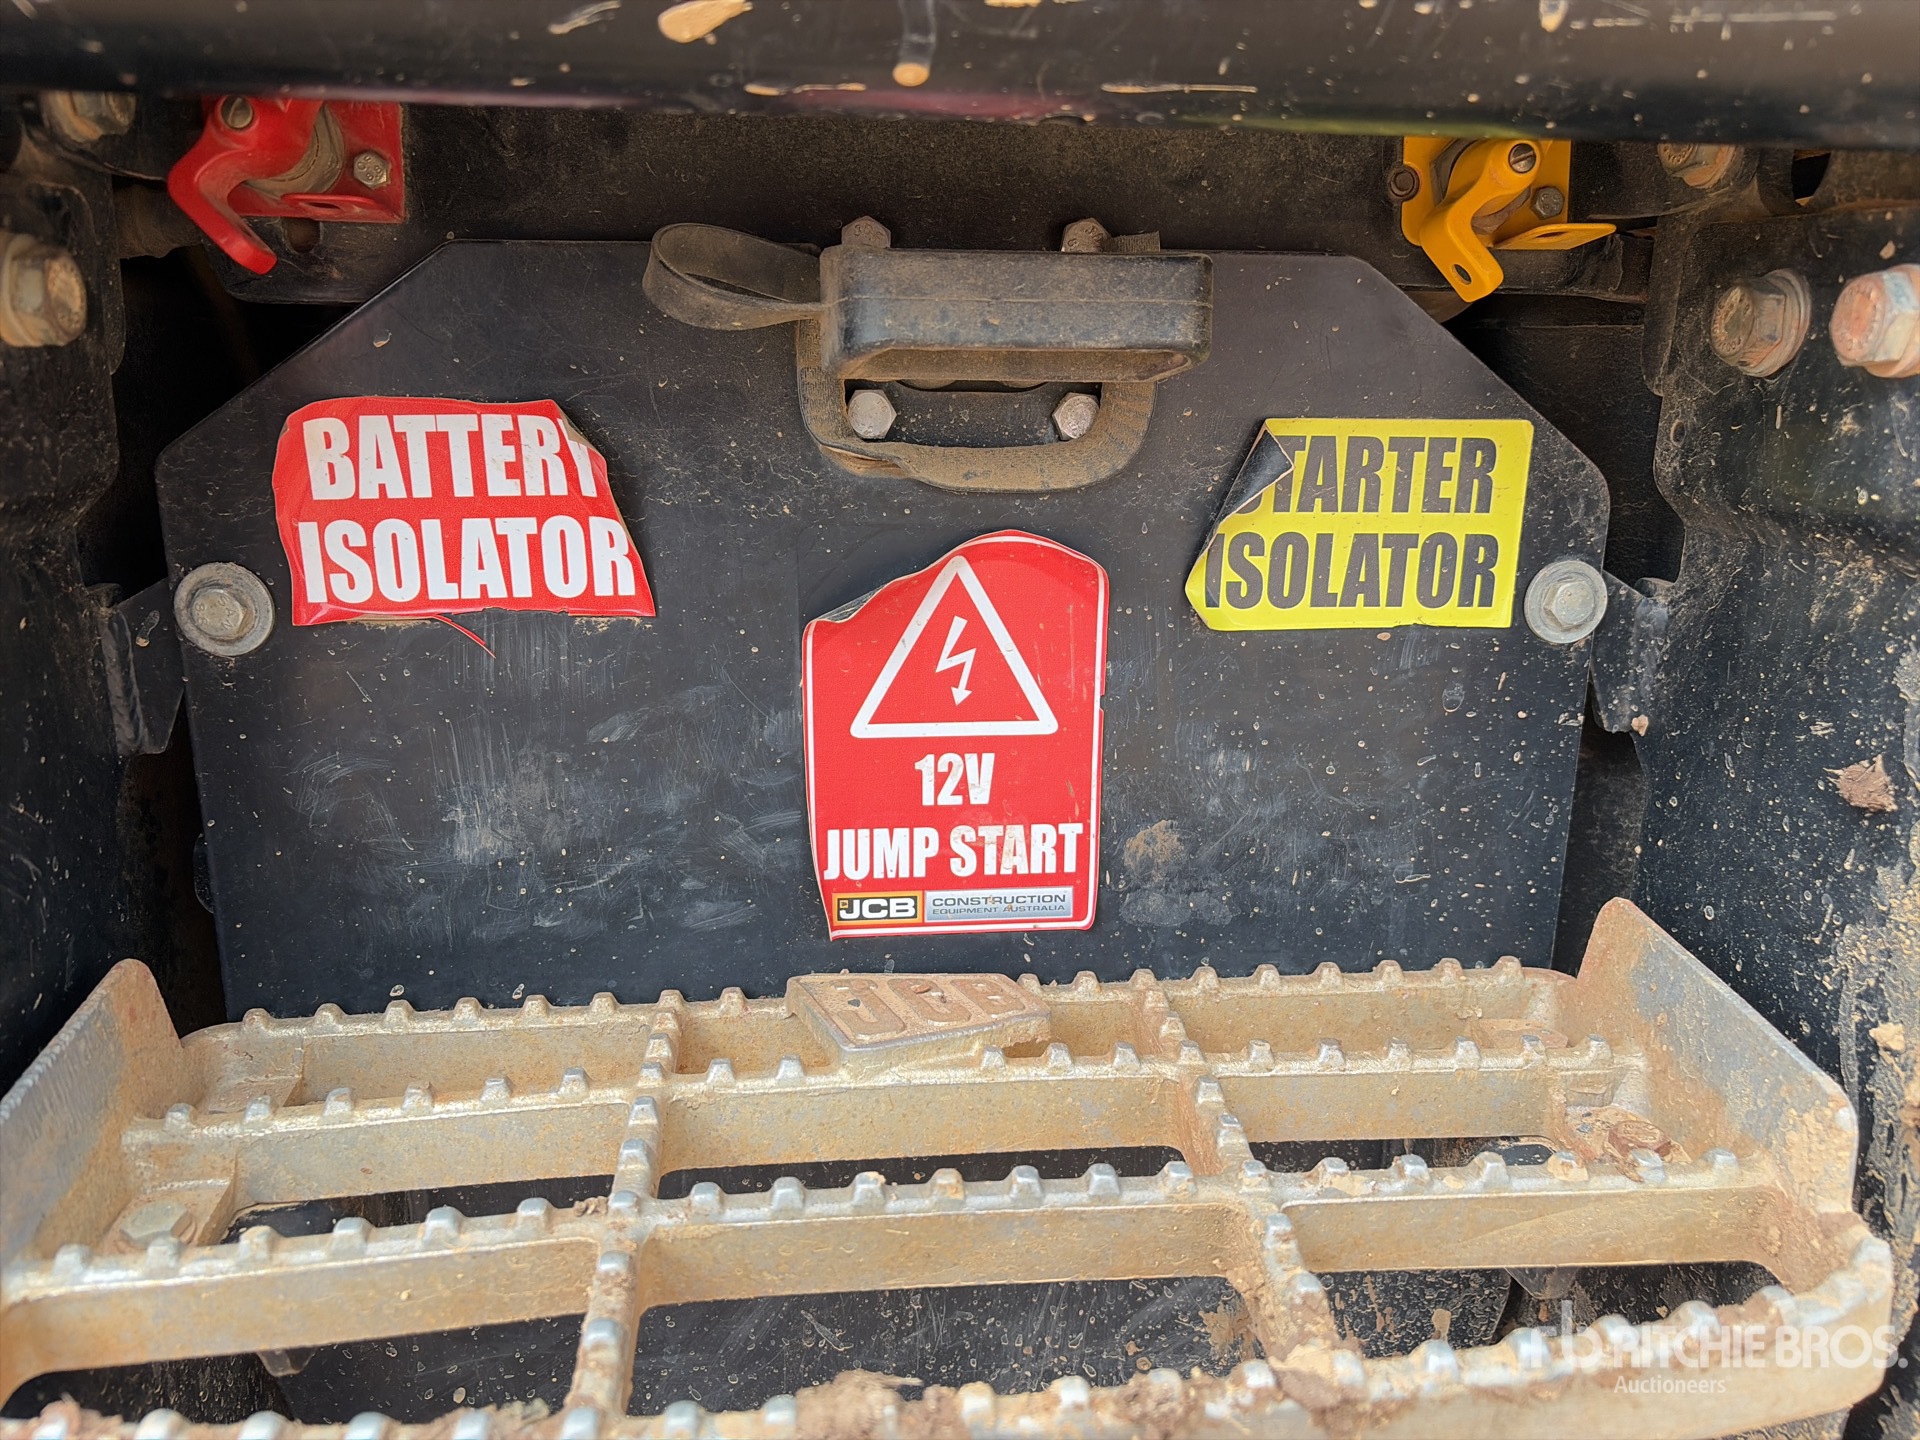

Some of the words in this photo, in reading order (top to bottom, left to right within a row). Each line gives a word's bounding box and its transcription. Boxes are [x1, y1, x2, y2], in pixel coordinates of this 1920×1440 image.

[1235, 434, 1497, 514] TARTER
[298, 515, 636, 604] ISOLATOR
[1205, 531, 1499, 610] ISOLATOR
[914, 752, 995, 806] 12V
[824, 827, 940, 881] JUMP
[949, 822, 1084, 878] START
[839, 896, 916, 921] JCB
[931, 894, 1067, 908] CONSTRUCTION
[931, 905, 999, 916] EQUIPMENT
[1002, 903, 1066, 914] AUSTRALIA
